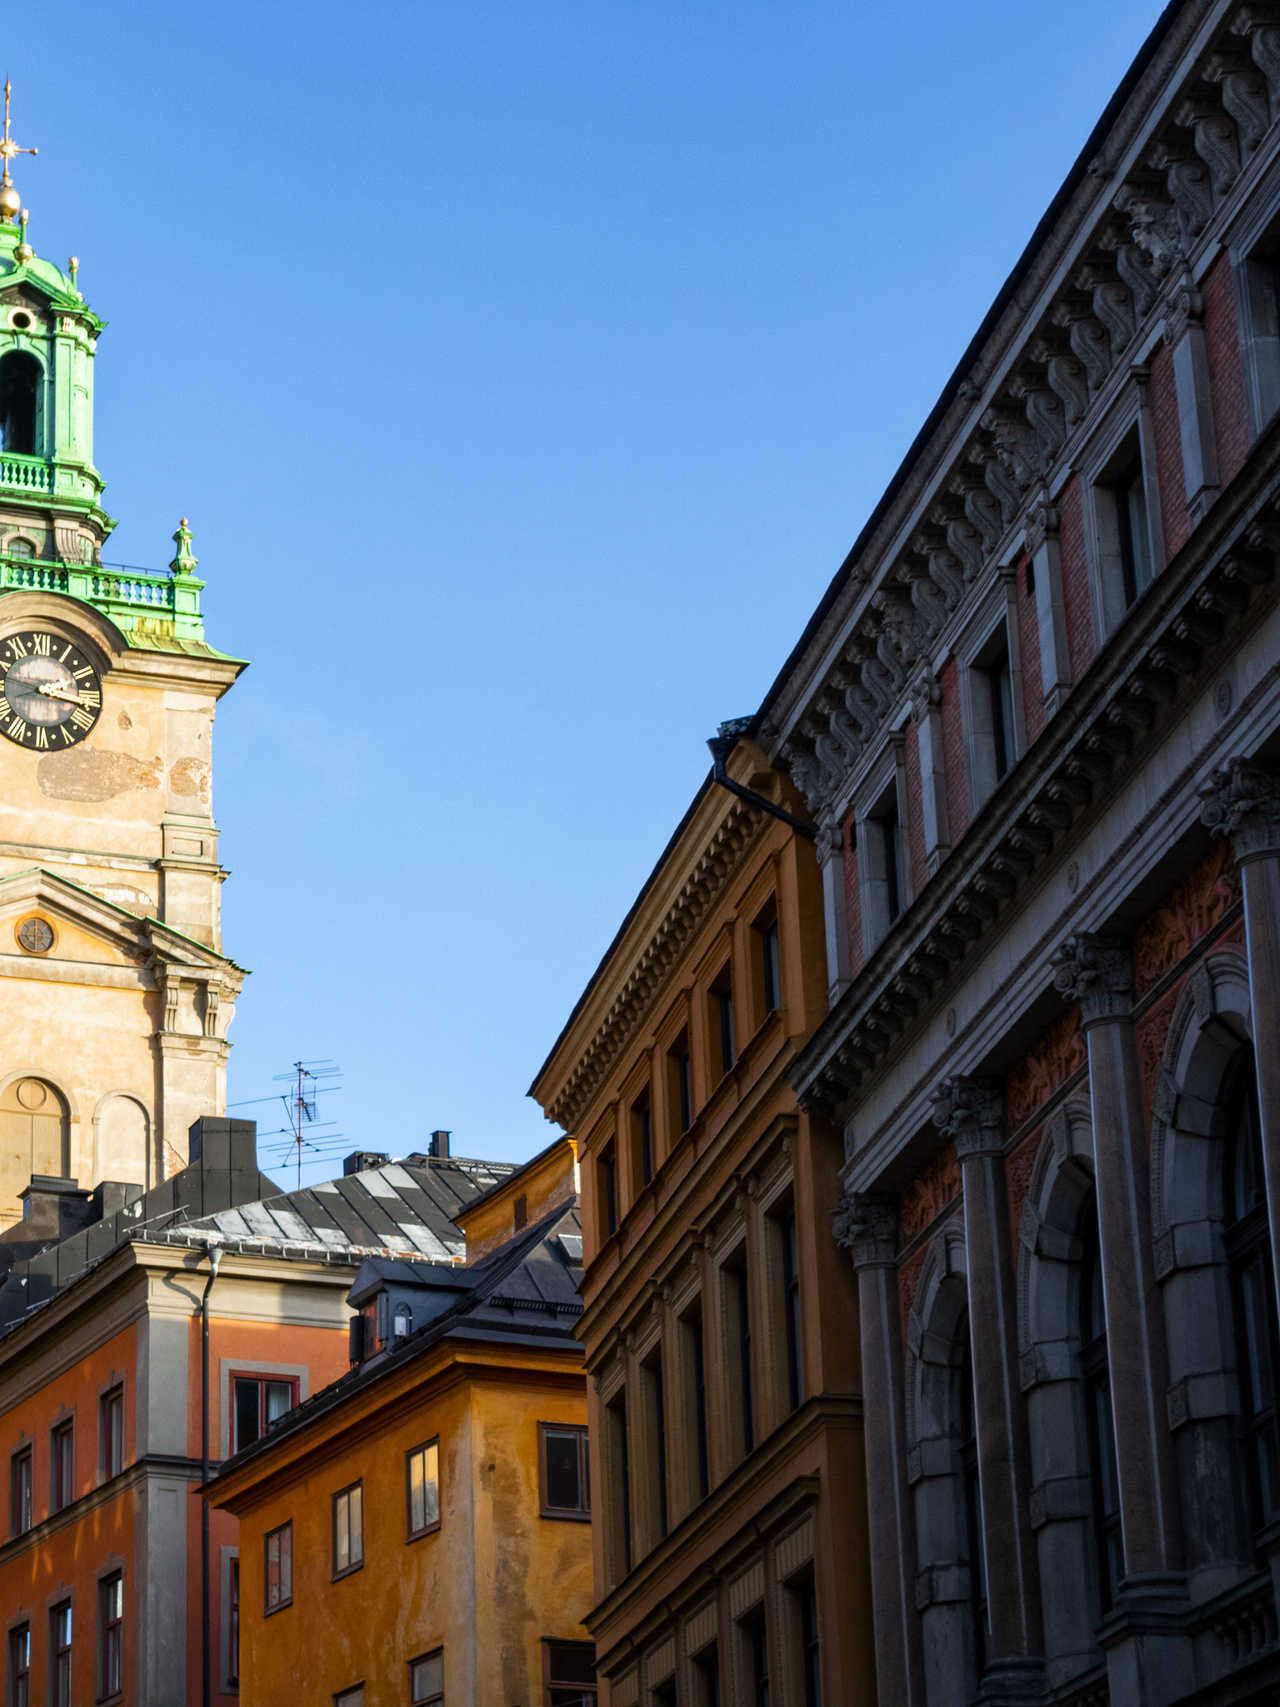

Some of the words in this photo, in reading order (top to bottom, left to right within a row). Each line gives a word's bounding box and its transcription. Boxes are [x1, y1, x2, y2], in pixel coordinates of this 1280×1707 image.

[7, 636, 28, 660] XI
[33, 634, 50, 656] XII
[59, 644, 72, 663] I
[73, 665, 94, 680] II
[7, 716, 26, 742] VII
[70, 707, 96, 731] IIII
[36, 726, 48, 748] VI
[60, 724, 75, 744] V
